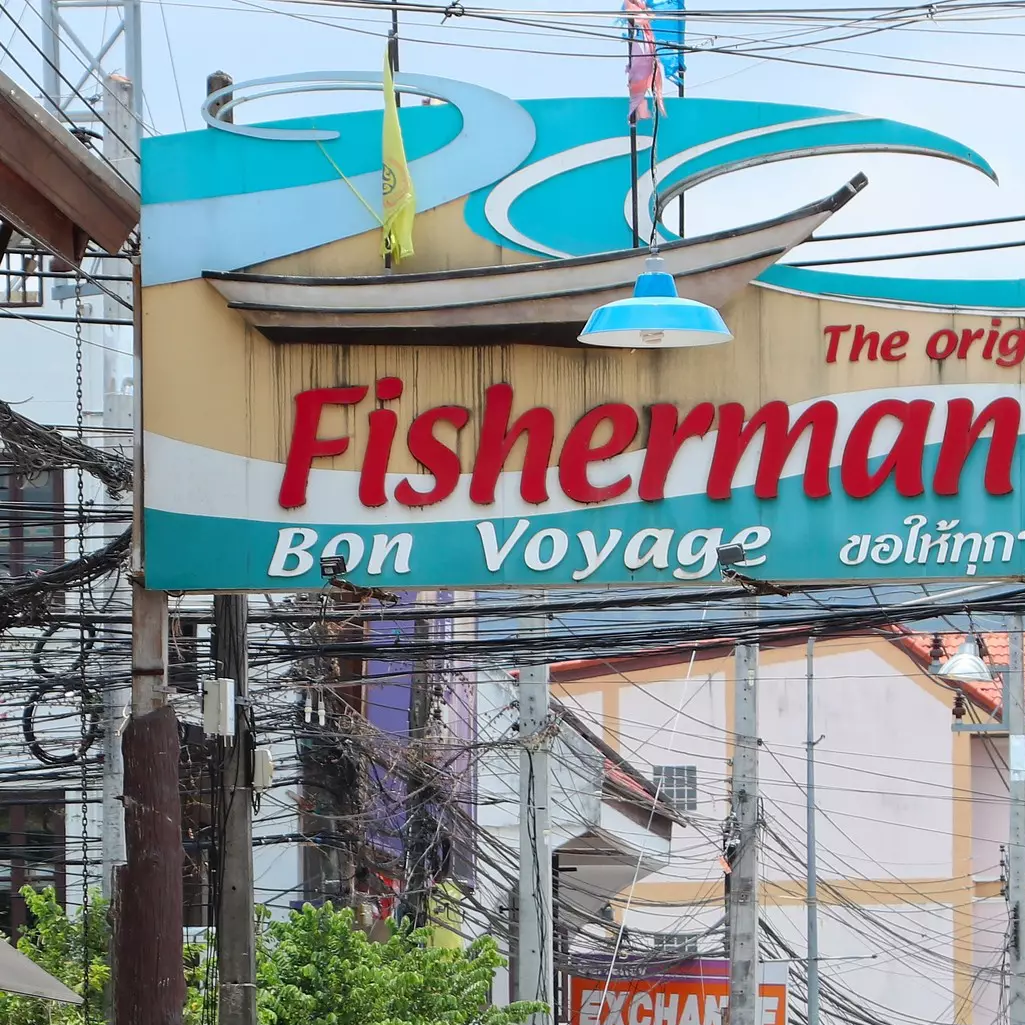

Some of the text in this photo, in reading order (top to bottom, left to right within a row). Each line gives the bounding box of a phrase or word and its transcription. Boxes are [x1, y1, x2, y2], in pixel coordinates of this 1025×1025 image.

[823, 323, 910, 363] The
[266, 518, 772, 581] Bon Voyage
